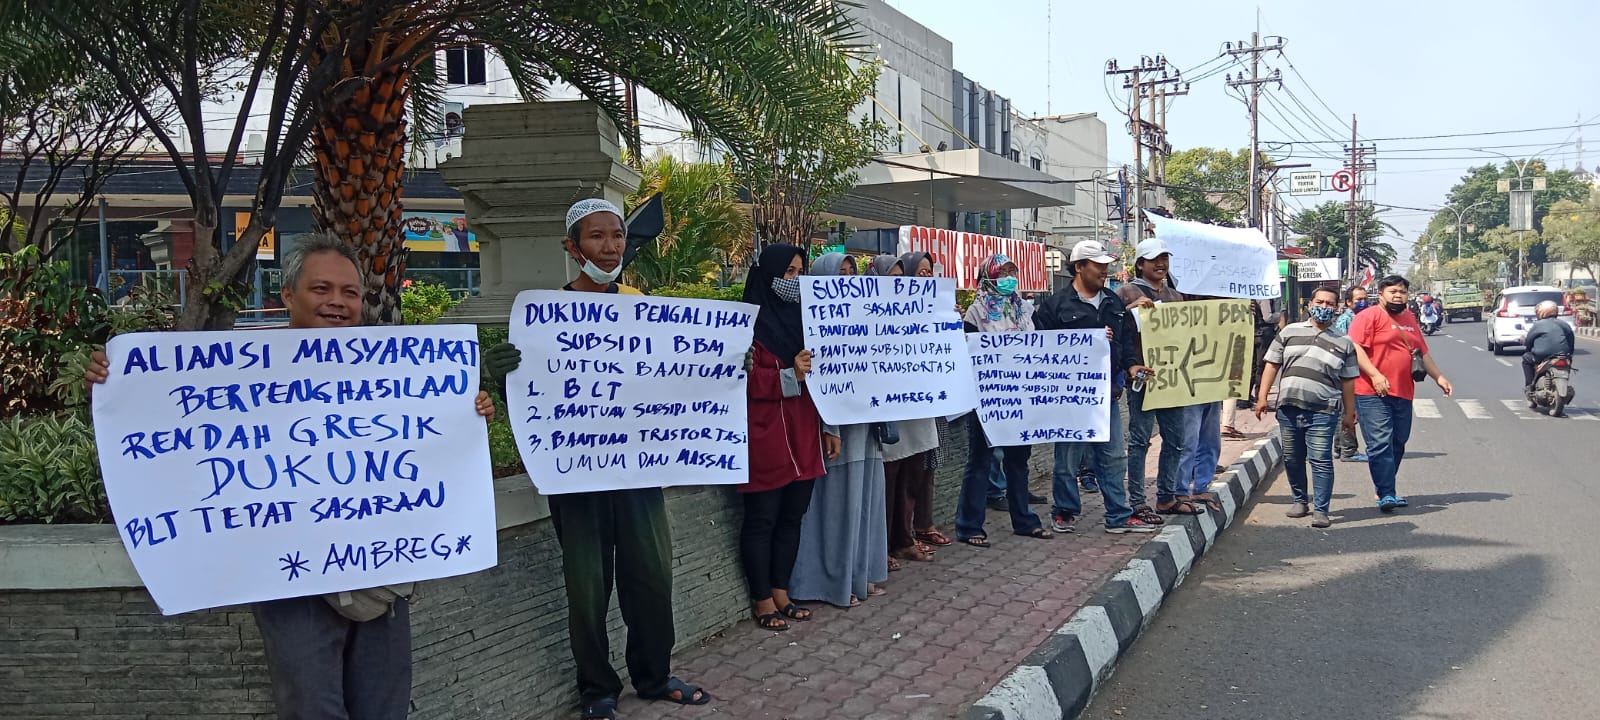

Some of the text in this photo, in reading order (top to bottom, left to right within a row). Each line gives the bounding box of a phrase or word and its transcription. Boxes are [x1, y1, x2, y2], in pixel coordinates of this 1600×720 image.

[813, 277, 936, 299] SUBSIDI BBM
[525, 302, 751, 328] DUKUNG PENGALIHAN
[808, 303, 851, 320] TEPAT
[1150, 302, 1253, 332] SUBSIDI BBM
[819, 324, 868, 337] BANTUAN
[876, 323, 928, 336] LANGSUNG
[557, 332, 723, 357] SUBSIDI BBM
[981, 333, 1092, 348] SUBSIDI BBM
[124, 336, 480, 375] ALIANSI MASYARAKAT
[820, 344, 867, 358] BANTUAN
[871, 344, 916, 355] SUBSIDI
[920, 343, 951, 355] UPAH
[1147, 345, 1179, 369] BLT
[548, 359, 624, 374] UNTUK
[819, 362, 867, 376] BANTUAN
[872, 361, 954, 374] TRANSPORTASI
[971, 354, 1001, 366] TEPAT
[978, 370, 1021, 381] BANTUAN
[168, 369, 470, 418] BERPENGHASILAN
[821, 381, 854, 395] UMUM
[979, 384, 1096, 394] BANTUAN SUBSIDI UPAH
[554, 403, 626, 419] BANTUAN
[633, 403, 686, 417] SUBSIDI
[692, 401, 728, 415] UPAH
[980, 395, 1103, 408] BANTUAN TRANSPORTASI
[982, 410, 1022, 423] UMUM
[120, 414, 442, 461] RENDAH GRESIK
[551, 431, 627, 450] BANTUAN
[557, 449, 741, 473] UMUM DAN MASSAL
[195, 448, 420, 502] DUKUNG
[123, 480, 447, 552] BLT TEPAT SASARAN
